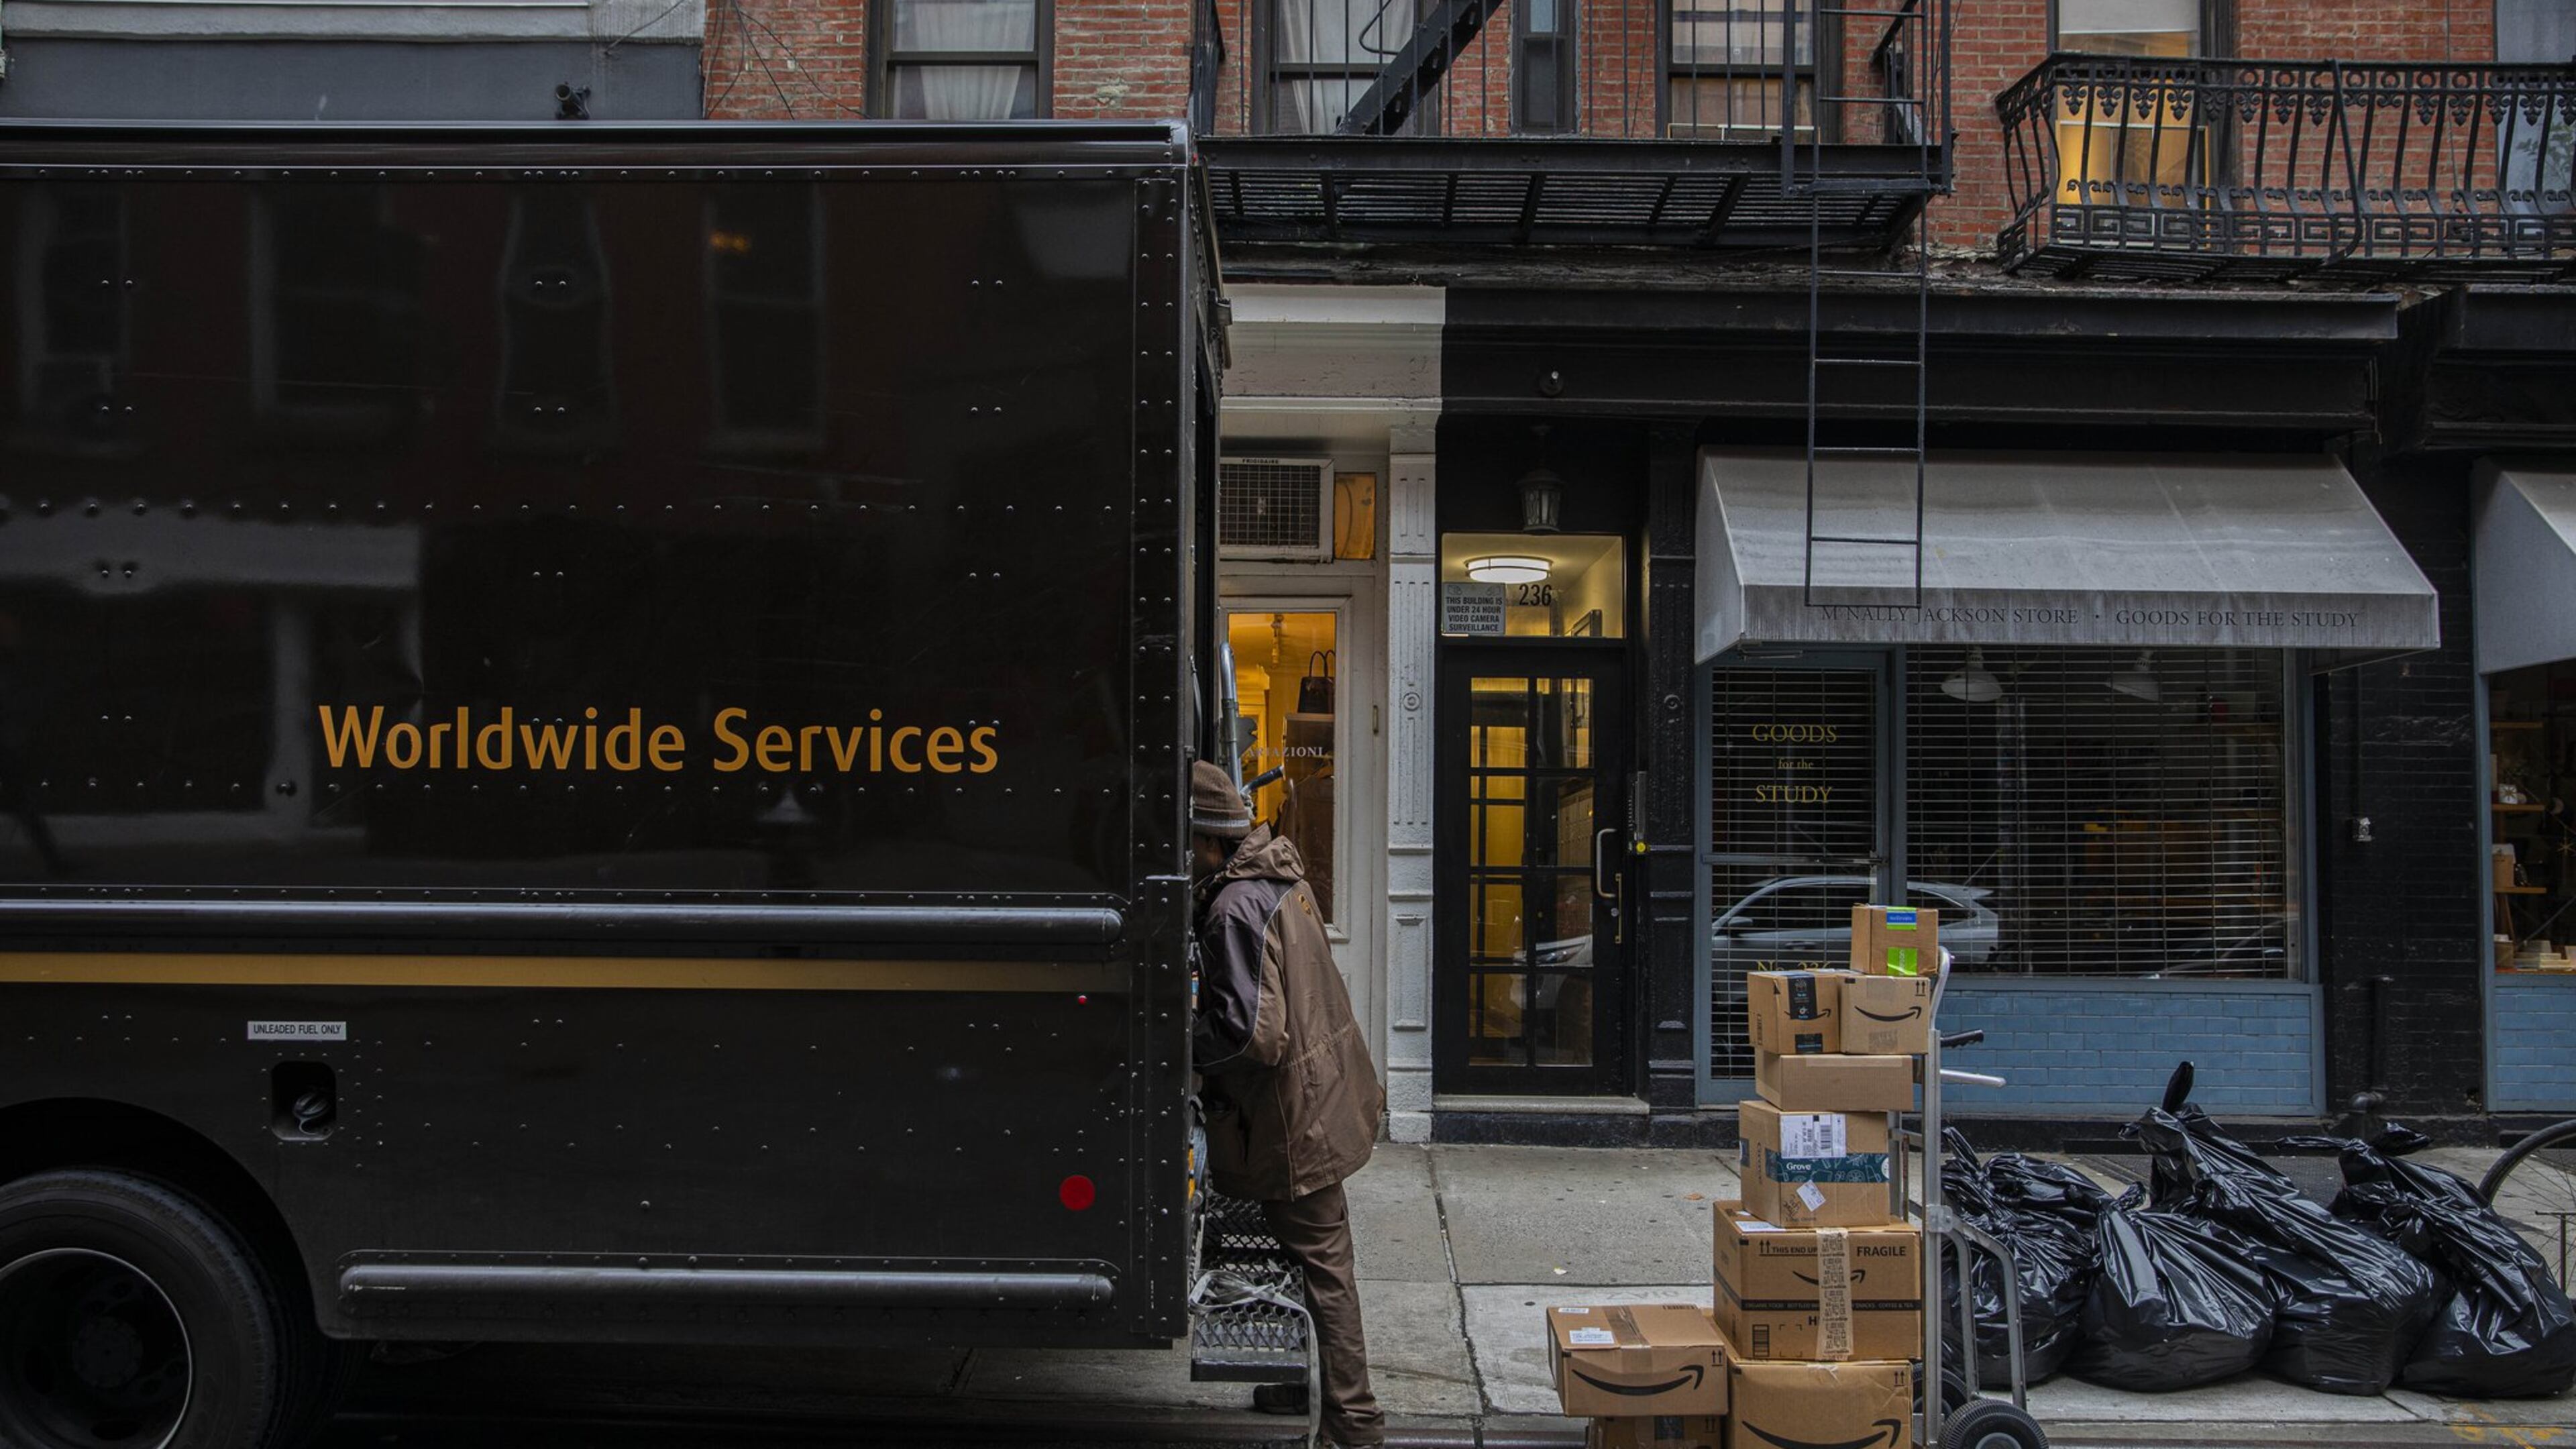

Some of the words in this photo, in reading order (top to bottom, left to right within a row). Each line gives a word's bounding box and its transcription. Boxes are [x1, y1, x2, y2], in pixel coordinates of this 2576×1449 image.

[1446, 596, 1461, 604] THIS
[1463, 596, 1494, 604] BUILDING
[1495, 596, 1503, 604] IS
[1519, 584, 1552, 606] 236
[1483, 606, 1501, 614] HOUR
[1448, 614, 1469, 623] VIDEO
[1470, 614, 1499, 623] CAMERA
[1914, 607, 2006, 625] JACKSON
[2013, 608, 2078, 624] STORE
[2116, 609, 2190, 625] GOODS
[2198, 610, 2237, 626] FOR
[2243, 611, 2285, 627] THE
[2292, 612, 2359, 627] STUDY
[1449, 623, 1499, 632] SURVEILLANCE
[1752, 723, 1837, 743] GOODS
[319, 704, 686, 771] Worldwide
[713, 706, 998, 773] Services
[1248, 746, 1324, 757] ARIAZIONI
[1778, 757, 1794, 769] for
[1797, 757, 1814, 769] the
[1755, 784, 1833, 804] STUDY
[253, 1024, 296, 1034] UNLEADED
[299, 1024, 318, 1034] FUEL
[321, 1024, 341, 1034] ONLY
[1786, 1162, 1812, 1171] Grove
[1856, 1246, 1907, 1256] FRAGILE
